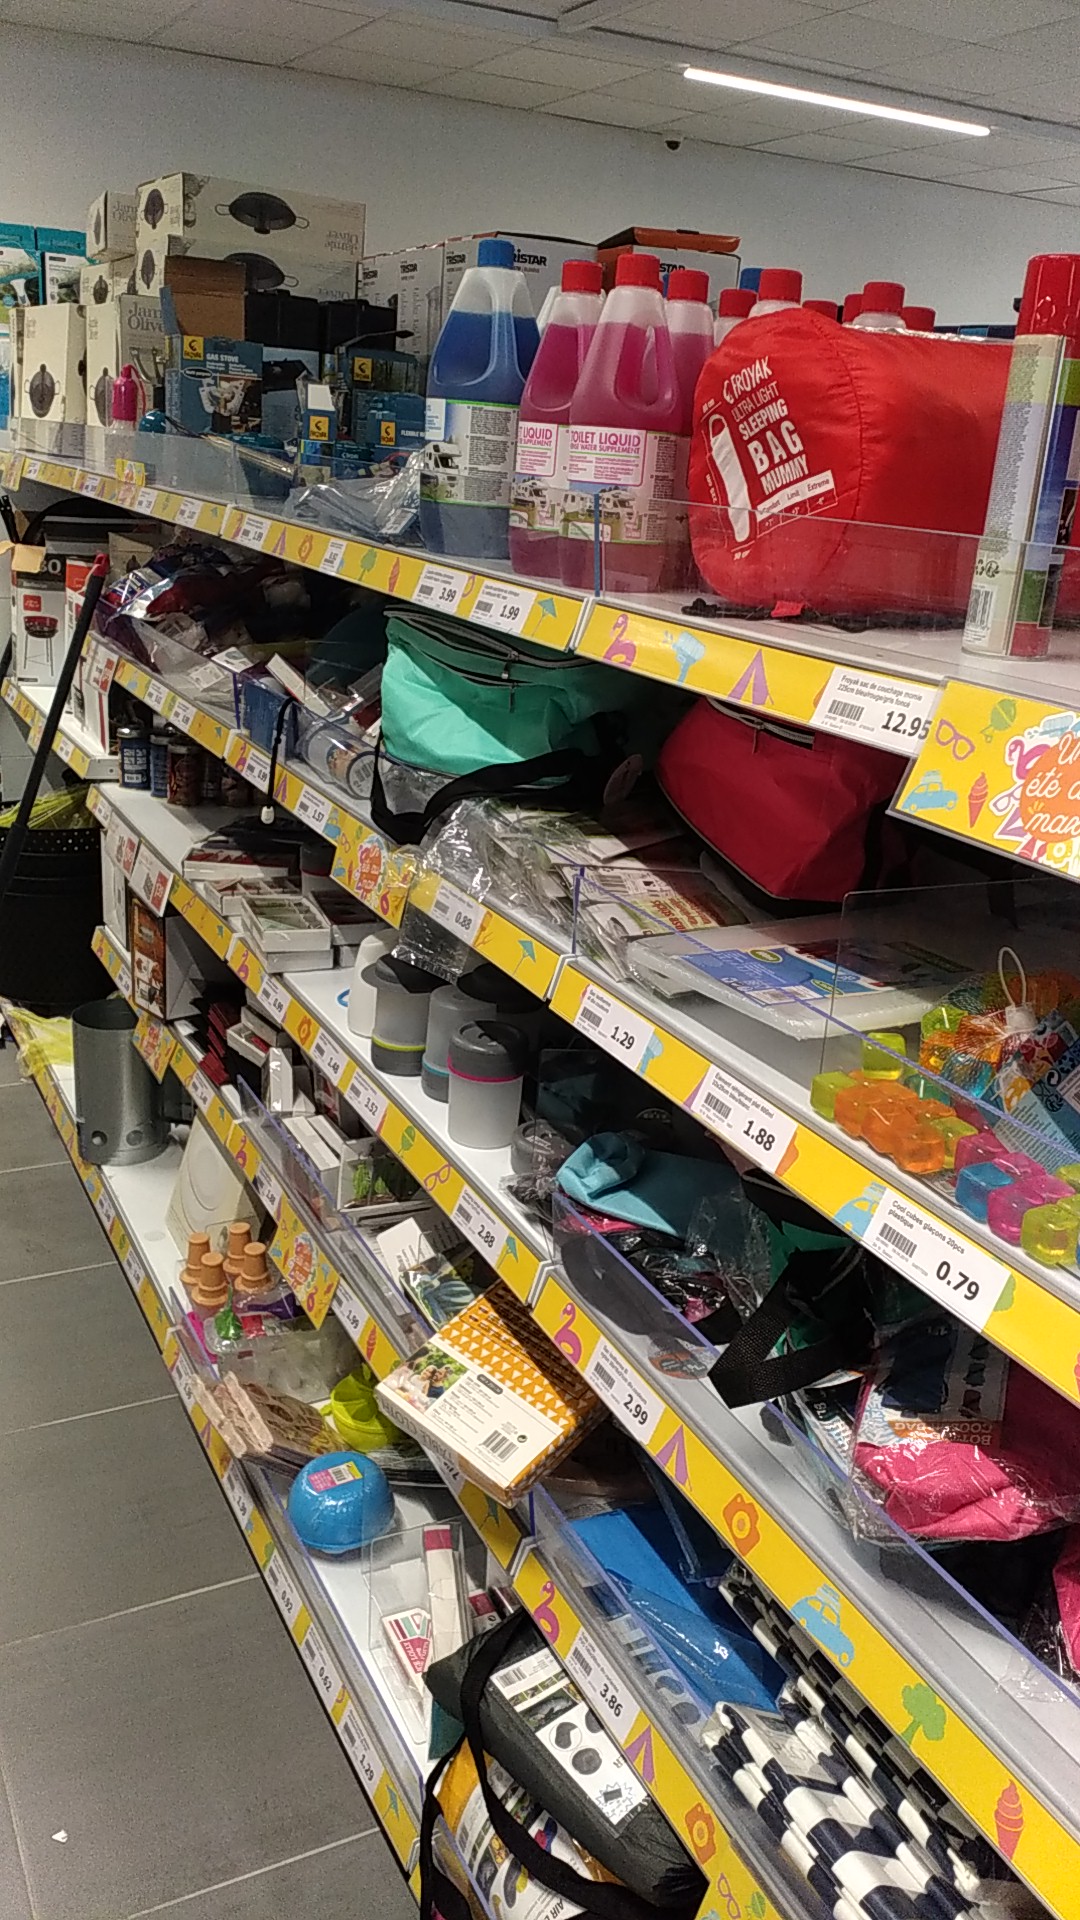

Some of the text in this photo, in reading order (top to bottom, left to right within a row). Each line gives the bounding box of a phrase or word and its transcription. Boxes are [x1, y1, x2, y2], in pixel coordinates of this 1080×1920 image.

[220, 354, 239, 364] STOVE
[731, 356, 773, 400] FROYAK
[731, 396, 755, 423] ULTRA
[753, 380, 780, 408] LIGHT
[739, 398, 788, 441] SLEEPING
[523, 427, 553, 440] LIQUID
[598, 432, 641, 448] LIQUID
[598, 445, 641, 455] SUPPLEMENT
[747, 420, 804, 475] BAG
[760, 454, 809, 496] MUMMY
[807, 478, 830, 492] Extreme
[787, 489, 800, 500] Limit
[439, 587, 457, 603] 3.99
[500, 604, 520, 620] 1.99
[881, 710, 933, 740] 12.95
[1026, 767, 1062, 798] été
[455, 911, 473, 931] 0.88
[611, 1025, 635, 1050] 1.29
[364, 1096, 379, 1117] 3.52
[743, 1120, 776, 1152] 1.88
[887, 1208, 914, 1230] plastique
[892, 1200, 966, 1255] Cool cubes glaçons 20pcs
[477, 1224, 496, 1249] 2.88
[936, 1260, 980, 1301] 0.79
[623, 1393, 649, 1426] 2.99
[318, 1666, 333, 1693] 0.62
[600, 1683, 623, 1717] 3.86
[359, 1754, 374, 1782] 1.29
[550, 1898, 564, 1919] AIR
